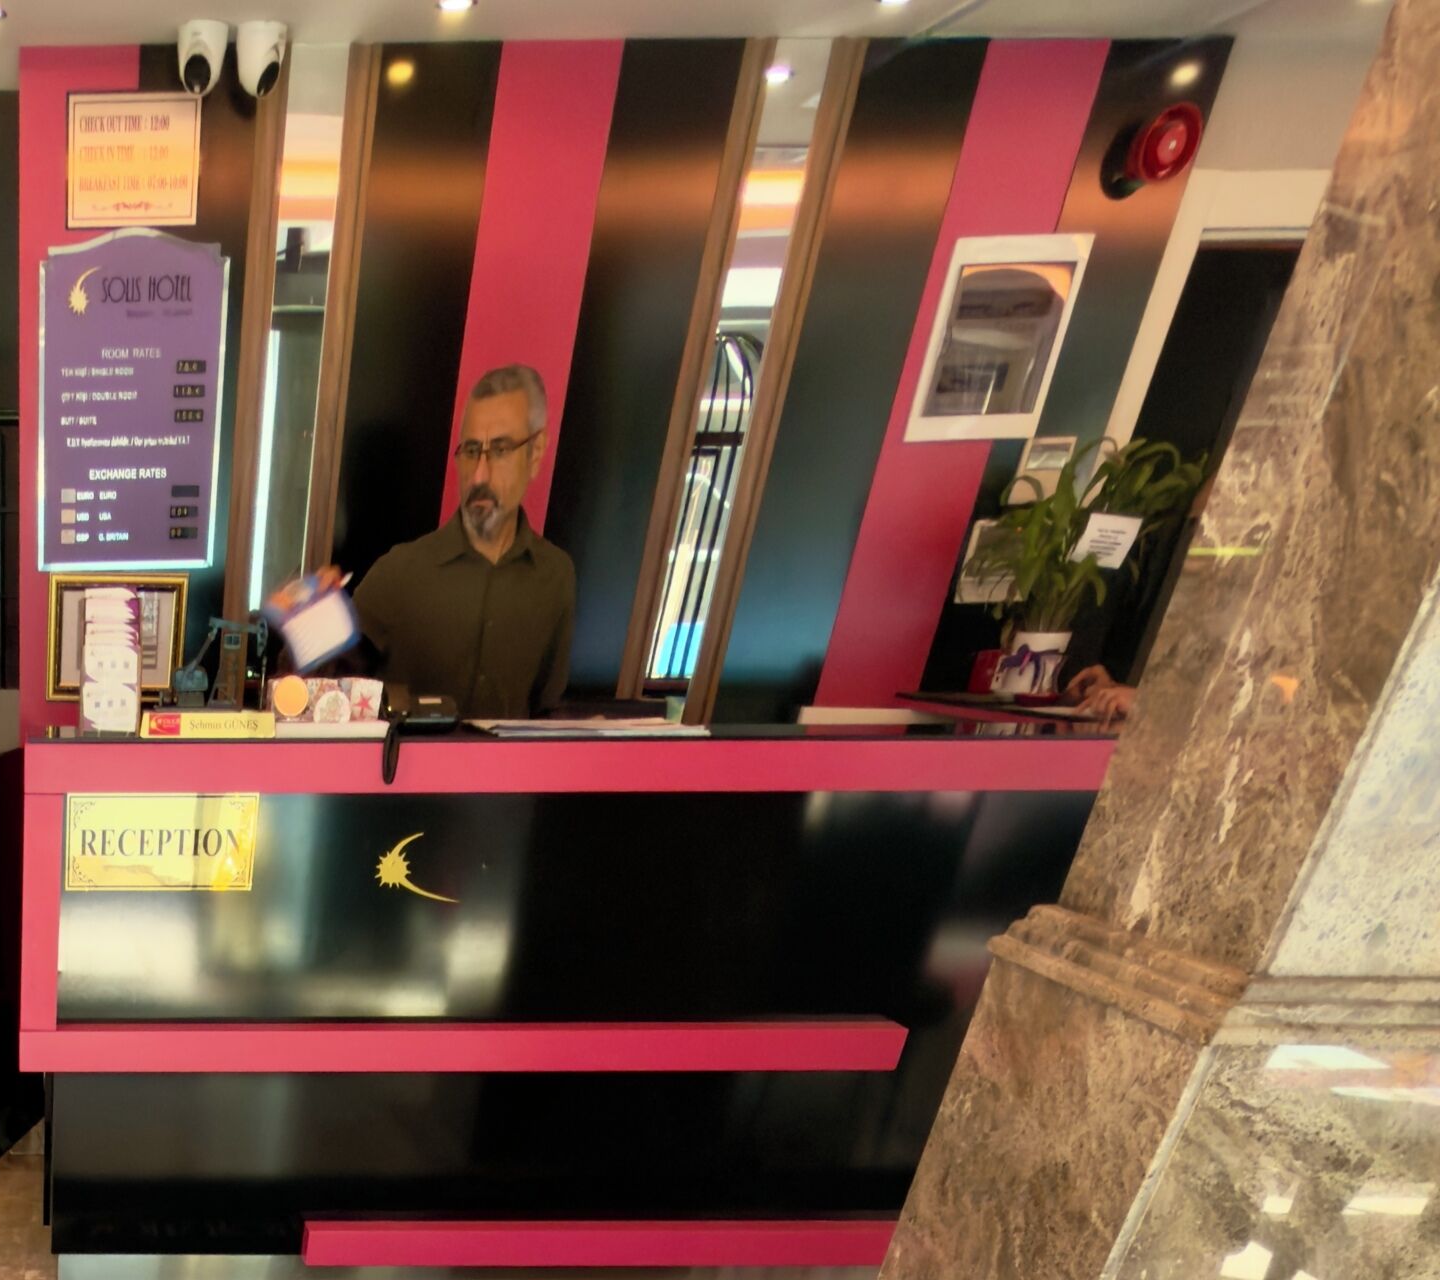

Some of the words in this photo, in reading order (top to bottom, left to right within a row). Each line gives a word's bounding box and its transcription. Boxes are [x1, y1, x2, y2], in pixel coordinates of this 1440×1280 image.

[101, 275, 141, 303] SOLIS
[147, 274, 192, 302] HOTEL
[101, 348, 128, 360] ROOM
[132, 347, 161, 359] RATES
[88, 468, 137, 480] EXCHANGE
[138, 467, 167, 479] RATES
[99, 491, 117, 500] EURO
[98, 512, 111, 521] USA
[80, 828, 242, 858] RECEPTION
